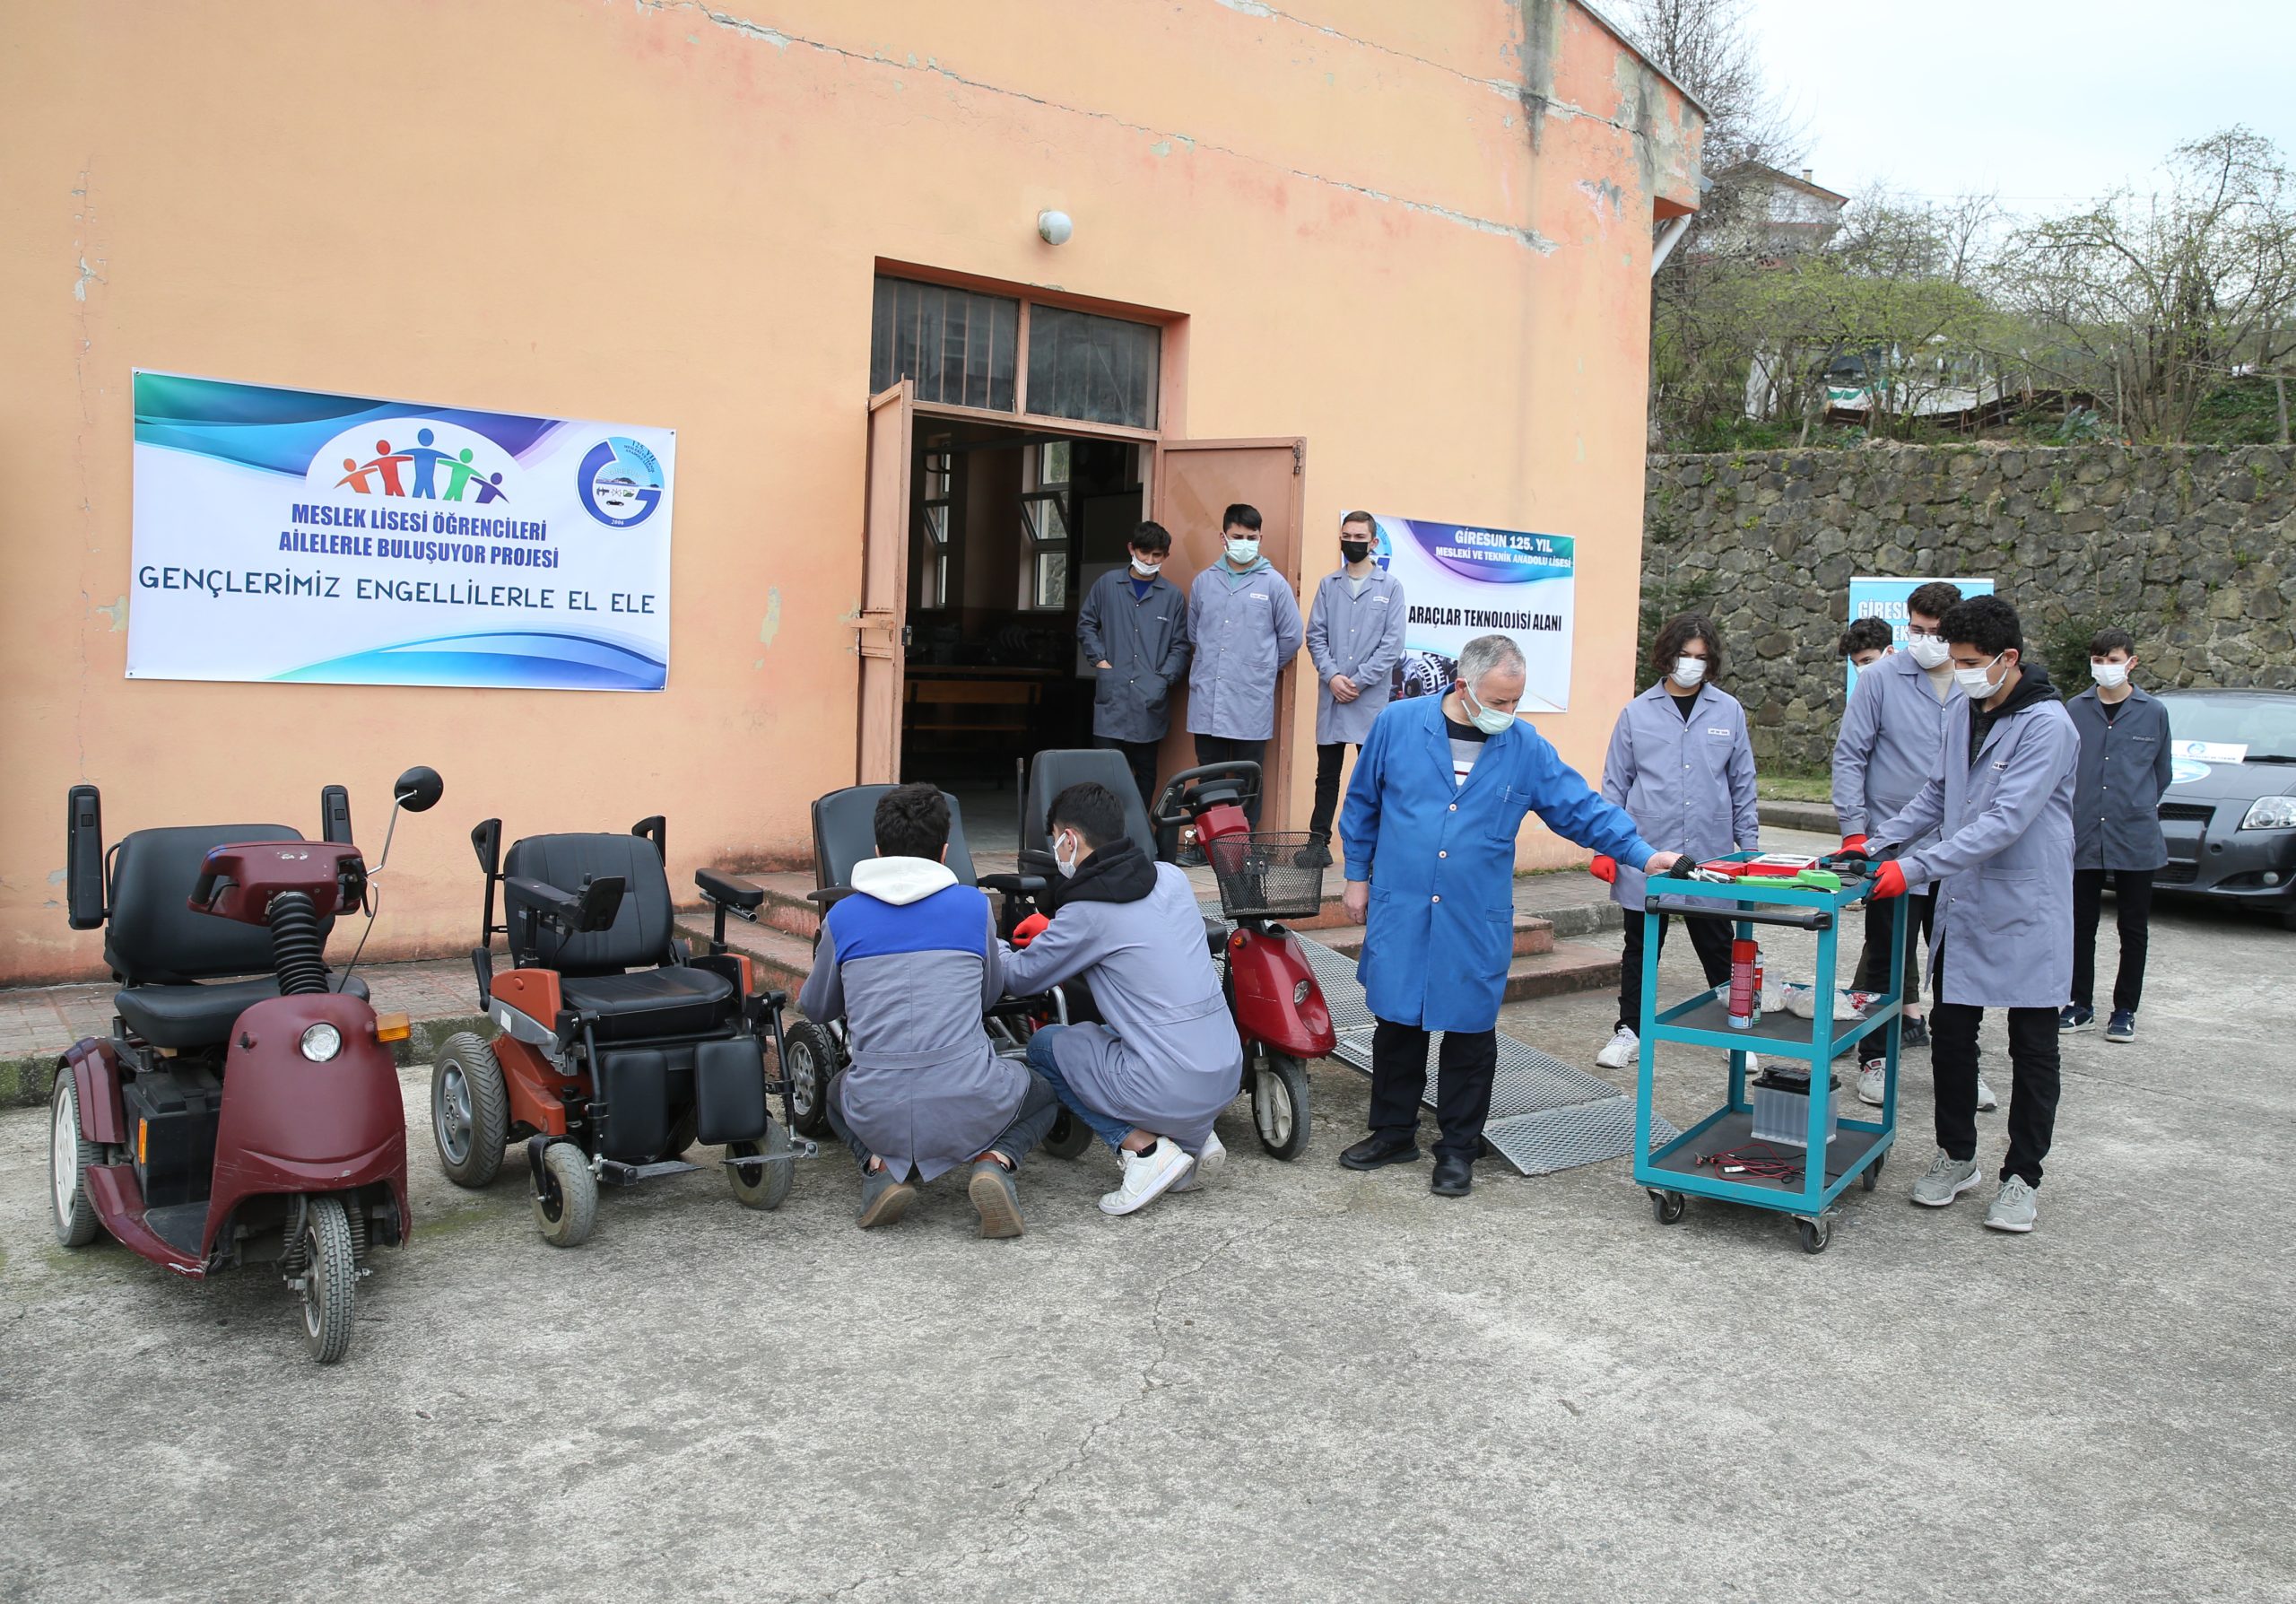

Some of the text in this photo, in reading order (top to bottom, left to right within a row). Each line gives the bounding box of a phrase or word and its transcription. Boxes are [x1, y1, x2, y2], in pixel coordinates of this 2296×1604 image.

[291, 503, 547, 541] MESLEK LİSESİ ÖĞRENCİLERİ
[279, 528, 559, 568] AİLELERLE BULUŞUYOR PROJESİ
[1455, 527, 1553, 553] GİRESUN 125. YIL
[1435, 546, 1571, 568] MESLEKİ VE TEKNİK ANADOLU LİSESİ
[139, 566, 655, 614] GENÇLERİMİZ ENGELLİLERLE EL ELE
[1408, 606, 1562, 632] ARAÇLAR TEKNOLOJİSİ ALANI
